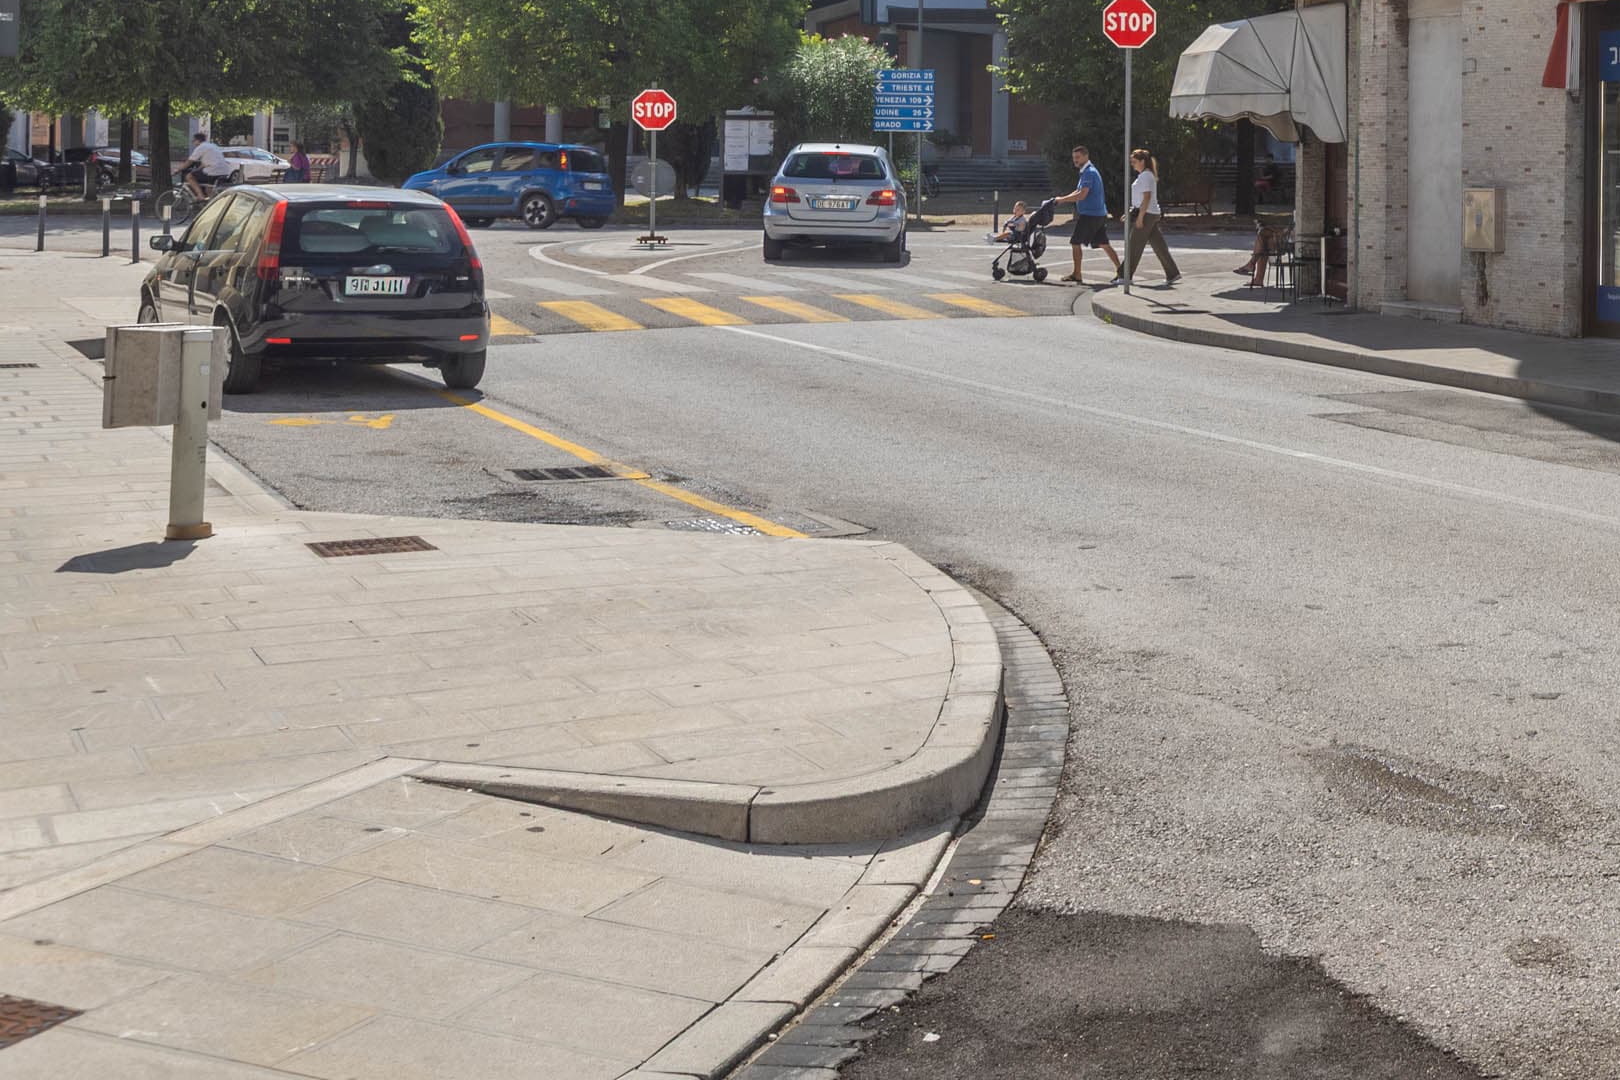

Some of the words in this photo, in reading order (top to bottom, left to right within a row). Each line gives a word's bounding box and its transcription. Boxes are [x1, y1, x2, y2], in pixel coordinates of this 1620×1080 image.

[1106, 12, 1153, 32] STOP
[875, 96, 907, 104] VENEZIA
[909, 96, 922, 104] 109
[635, 102, 674, 118] STOP
[875, 108, 900, 116] UDINE
